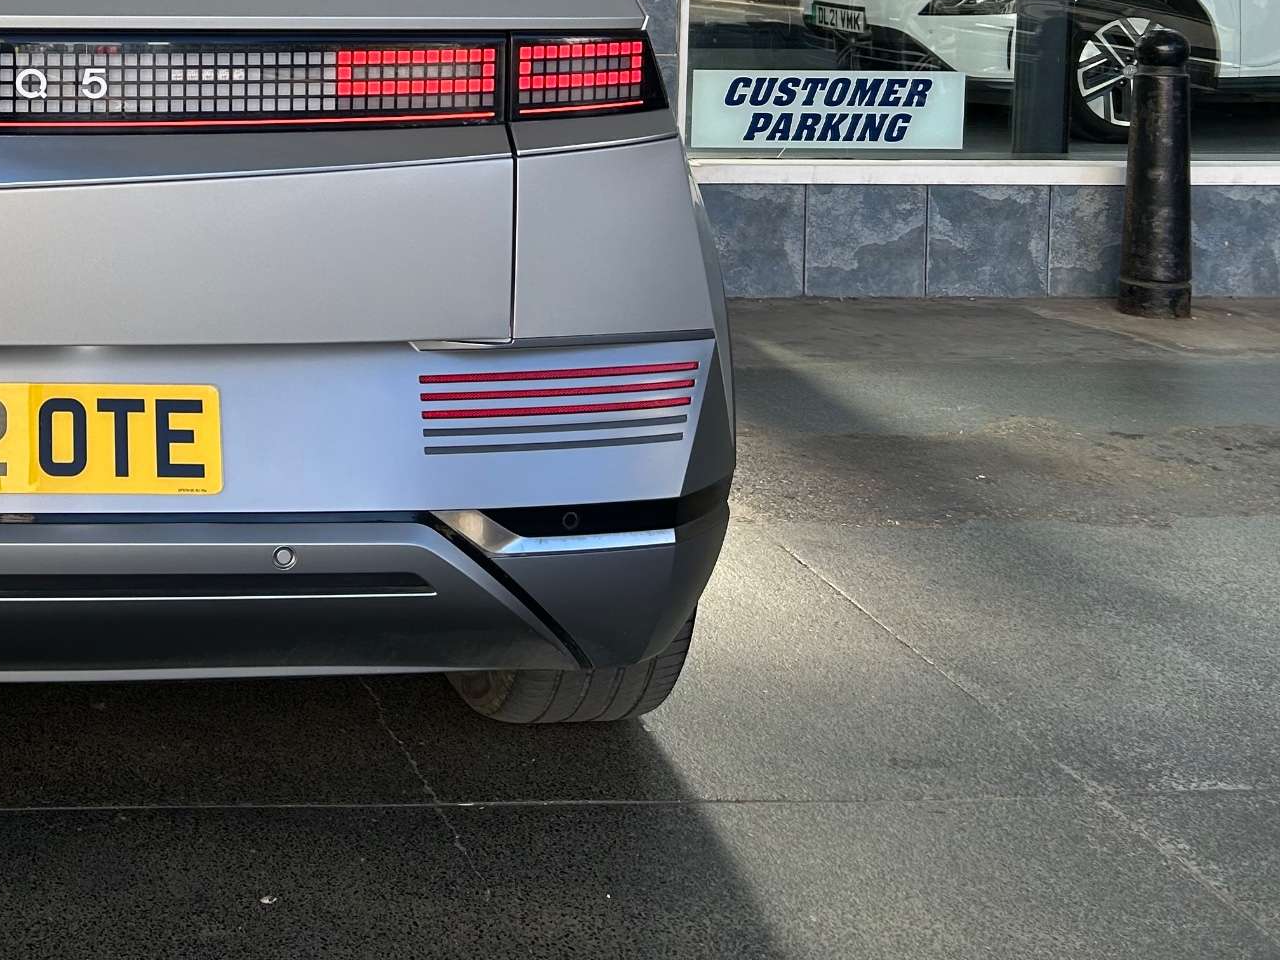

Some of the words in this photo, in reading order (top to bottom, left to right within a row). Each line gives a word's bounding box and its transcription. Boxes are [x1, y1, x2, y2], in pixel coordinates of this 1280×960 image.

[818, 6, 838, 27] DL21
[840, 10, 860, 31] VMK
[81, 68, 108, 99] 5
[724, 76, 933, 108] CUSTOMER
[742, 112, 913, 142] PARKING
[38, 397, 206, 478] OTE
